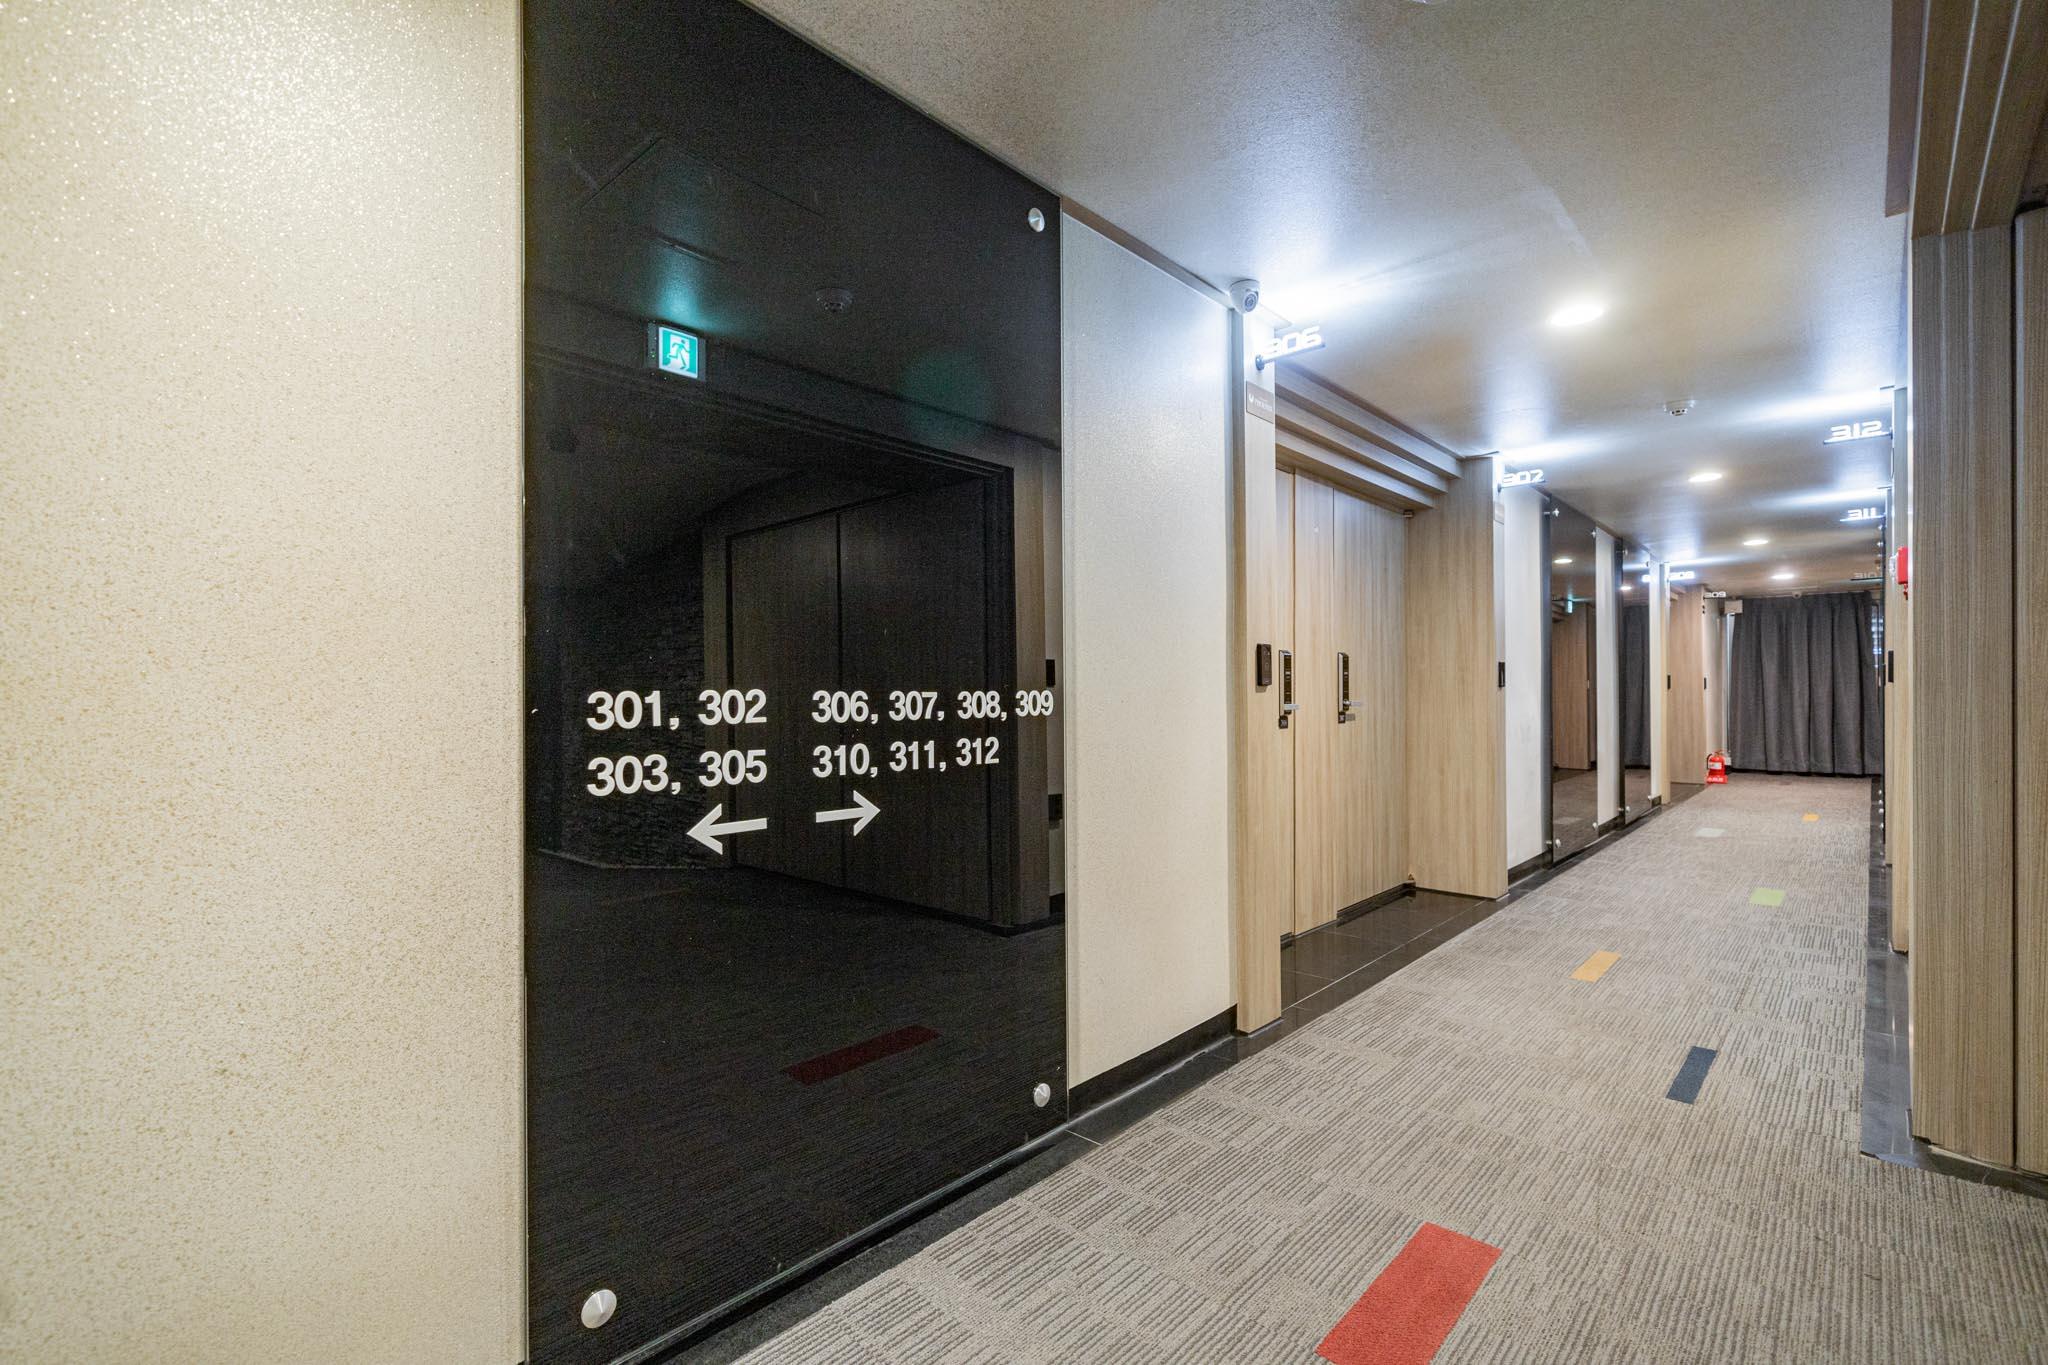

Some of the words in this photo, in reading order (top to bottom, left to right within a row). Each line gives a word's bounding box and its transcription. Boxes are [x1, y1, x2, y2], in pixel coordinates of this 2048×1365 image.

[1830, 420, 1882, 440] 312
[1847, 507, 1877, 519] 311
[587, 691, 679, 730] 301,
[698, 689, 766, 725] 302
[812, 690, 878, 724] 306,
[889, 691, 944, 721] 307,
[958, 691, 1007, 721] 308,
[1016, 690, 1053, 716] 309
[587, 754, 680, 796] 303,
[699, 750, 767, 786] 305
[813, 743, 877, 777] 310,
[890, 741, 946, 771] 311,
[956, 737, 999, 766] 312
